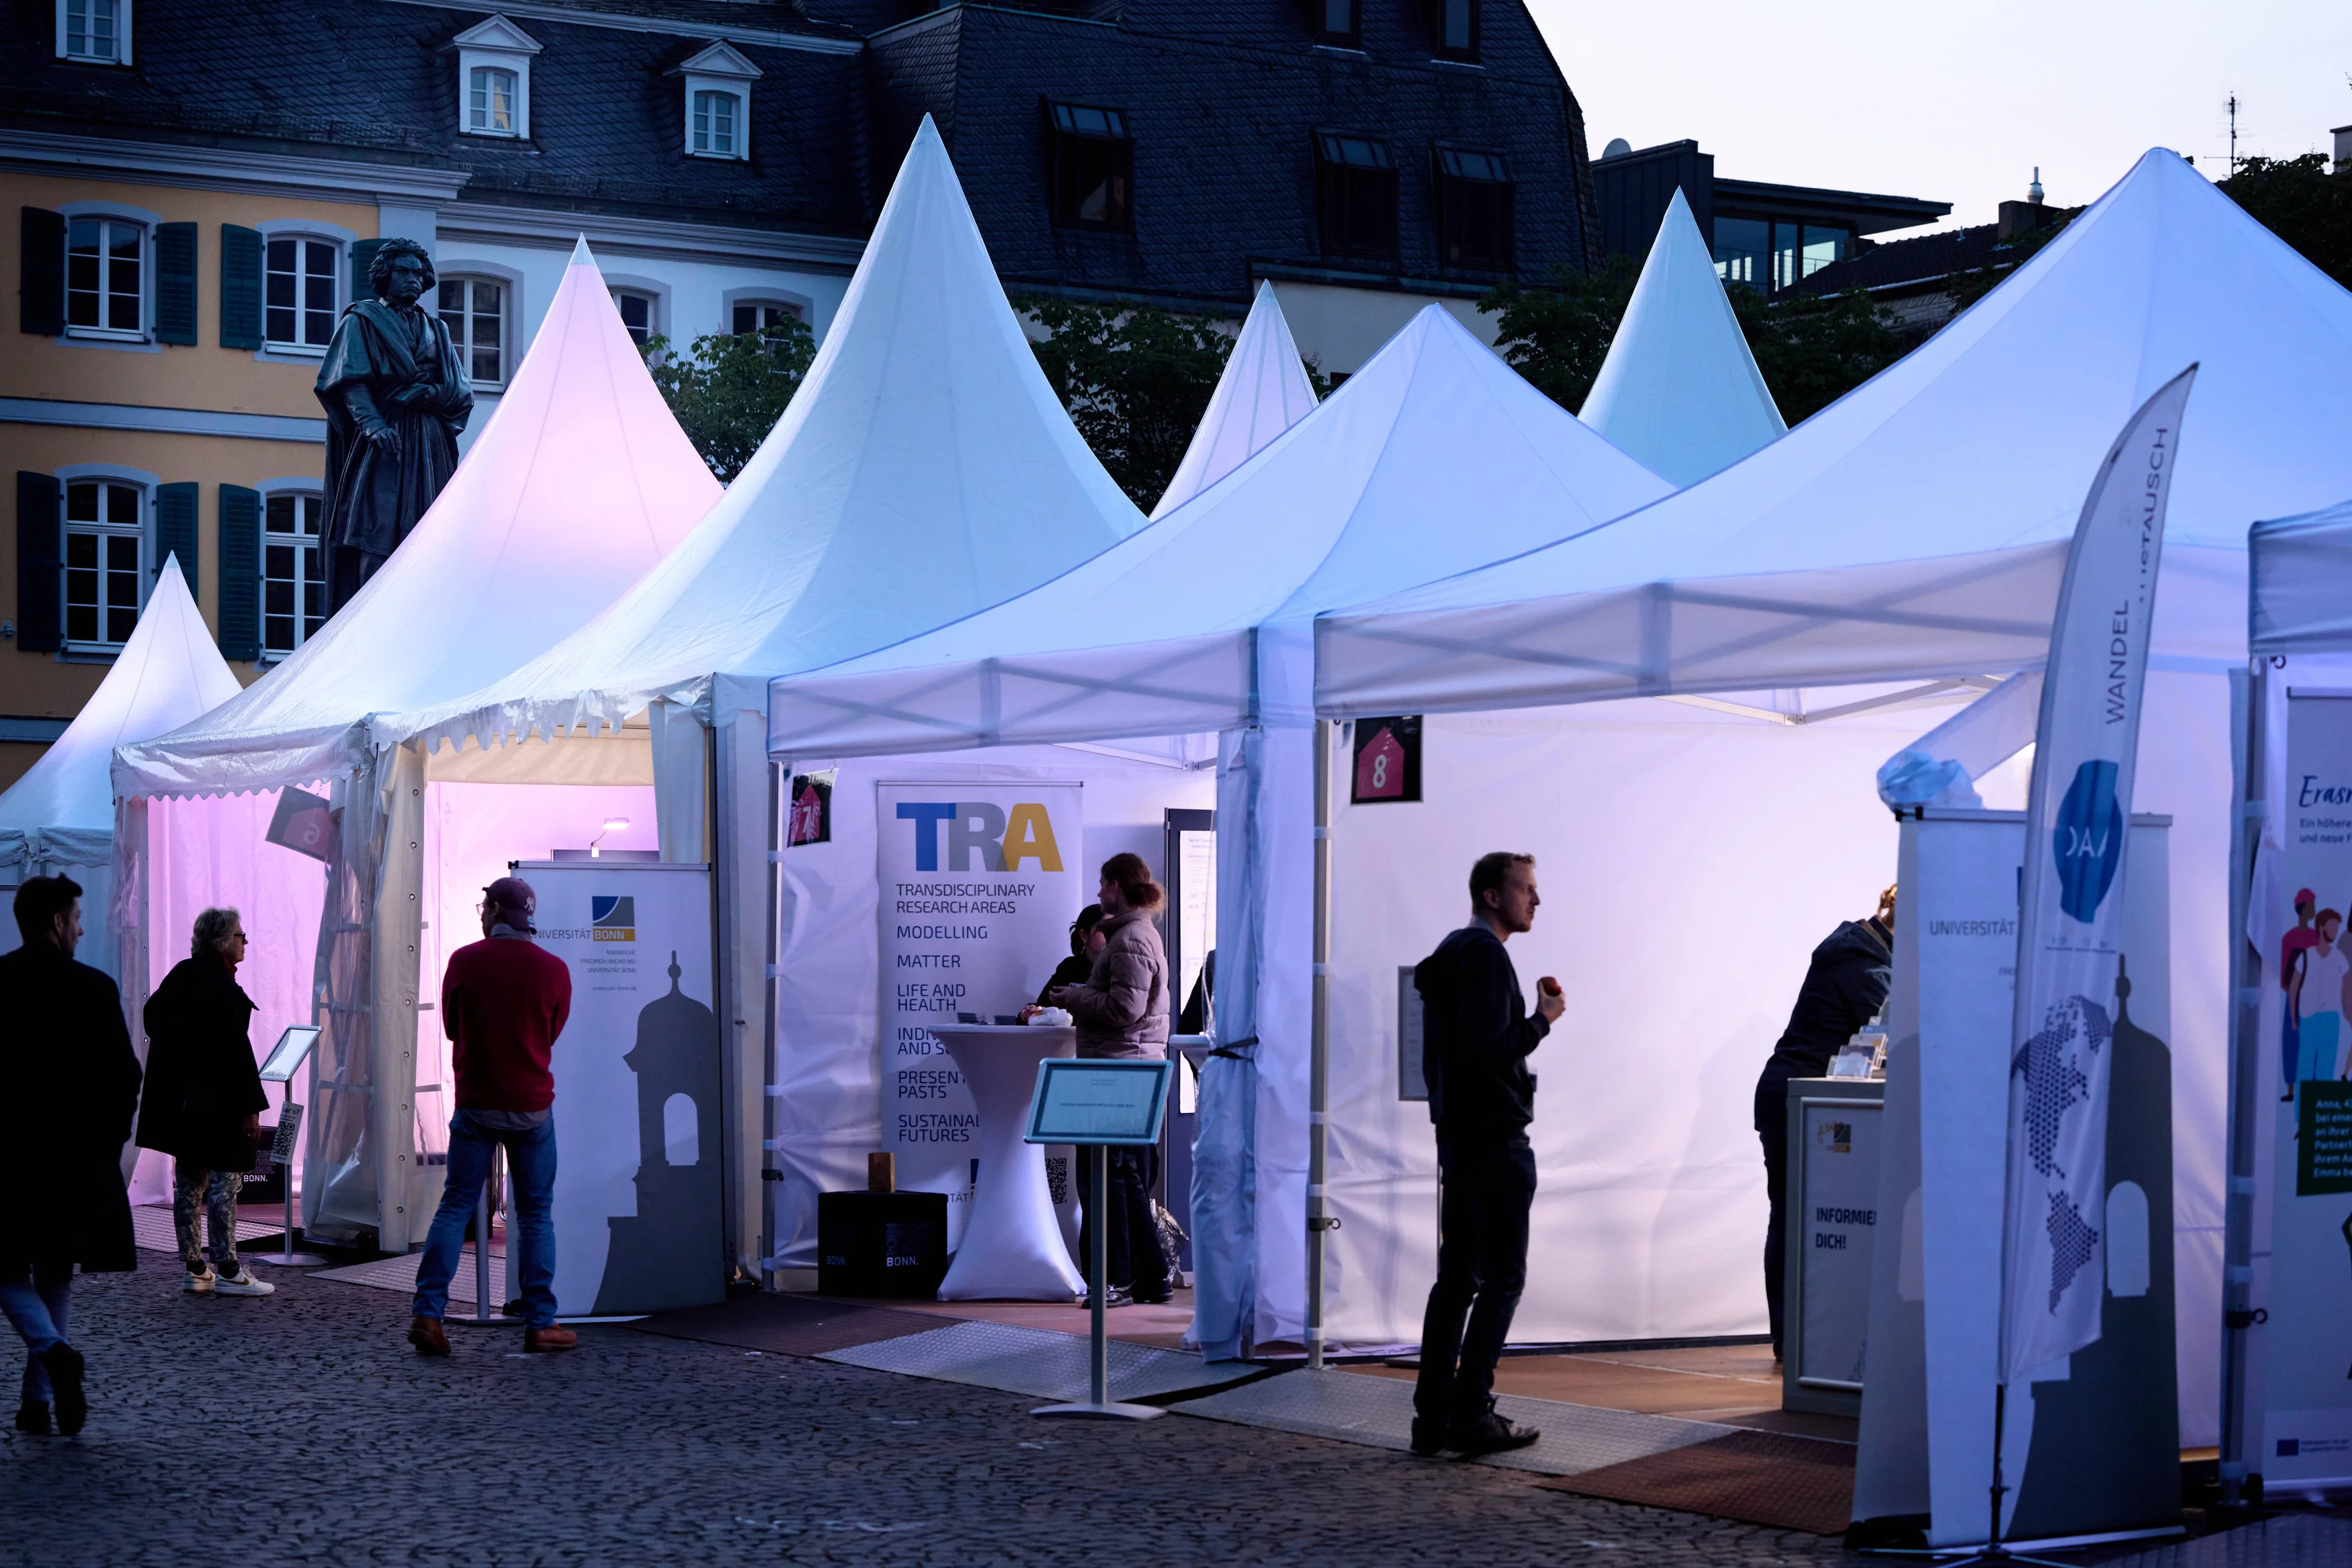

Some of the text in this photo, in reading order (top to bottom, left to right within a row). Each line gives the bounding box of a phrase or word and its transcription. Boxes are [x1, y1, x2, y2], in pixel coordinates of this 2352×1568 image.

[2105, 600, 2128, 725] WANDEL
[1373, 754, 1387, 788] 8
[802, 805, 812, 833] 7
[2300, 818, 2315, 828] Ein
[896, 802, 1064, 872] TRA
[2299, 834, 2318, 843] und
[2320, 834, 2345, 843] neue
[896, 884, 1035, 896] TRANSDISCIPLINARY
[897, 902, 1015, 914] RESEARCH AREAS
[897, 926, 987, 939] MODELLING
[1929, 918, 2015, 936] UNIVERSITÄT
[595, 930, 624, 940] BONN
[897, 955, 960, 967] MATTER
[898, 984, 966, 997] LIFE AND
[898, 998, 956, 1011] HEALTH
[898, 1042, 931, 1055] AND
[898, 1086, 947, 1098] PASTS
[2316, 1113, 2330, 1123] bei
[899, 1129, 970, 1142] FUTURES
[243, 1174, 268, 1182] BONN.
[1816, 1233, 1847, 1250] DICH!
[826, 1255, 847, 1266] BONN.
[887, 1256, 919, 1267] BONN.
